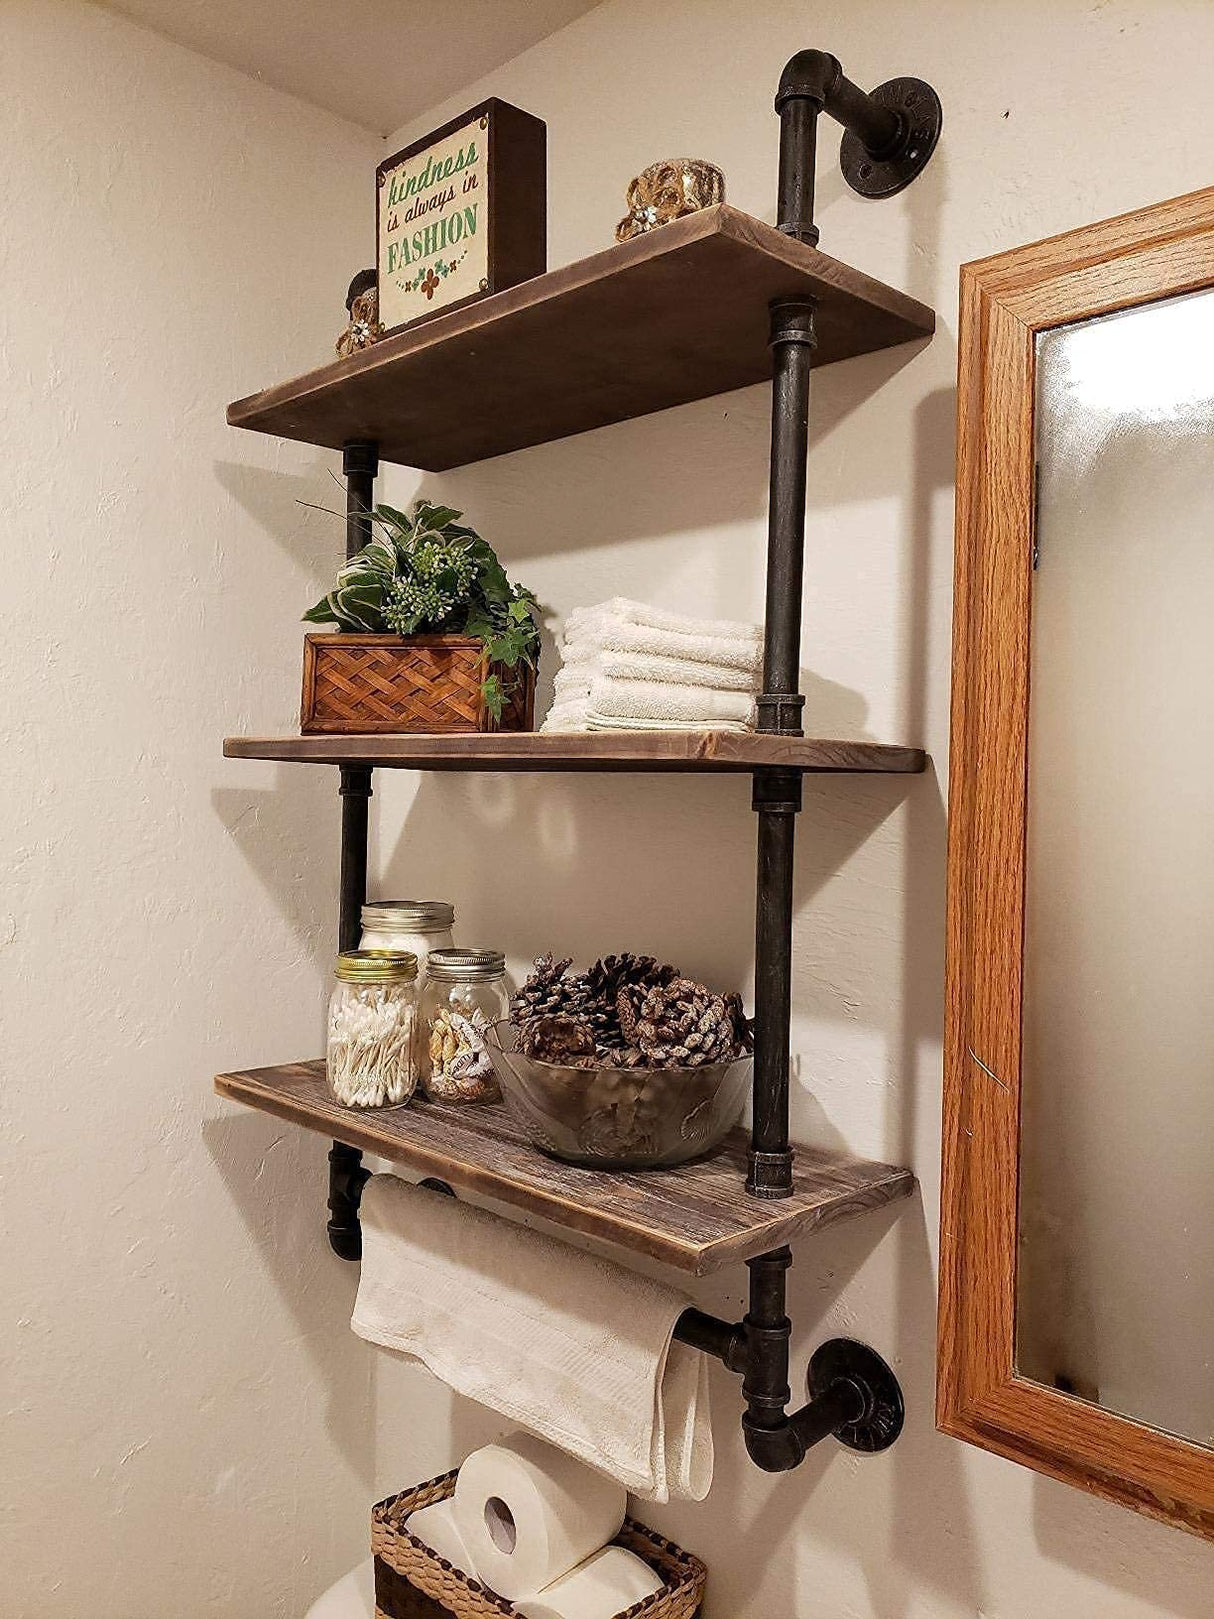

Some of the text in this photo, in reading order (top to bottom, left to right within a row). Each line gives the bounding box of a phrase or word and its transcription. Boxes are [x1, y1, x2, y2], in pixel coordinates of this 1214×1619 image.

[387, 171, 479, 233] is always in
[388, 142, 479, 208] kindness
[387, 203, 478, 274] FASHION
